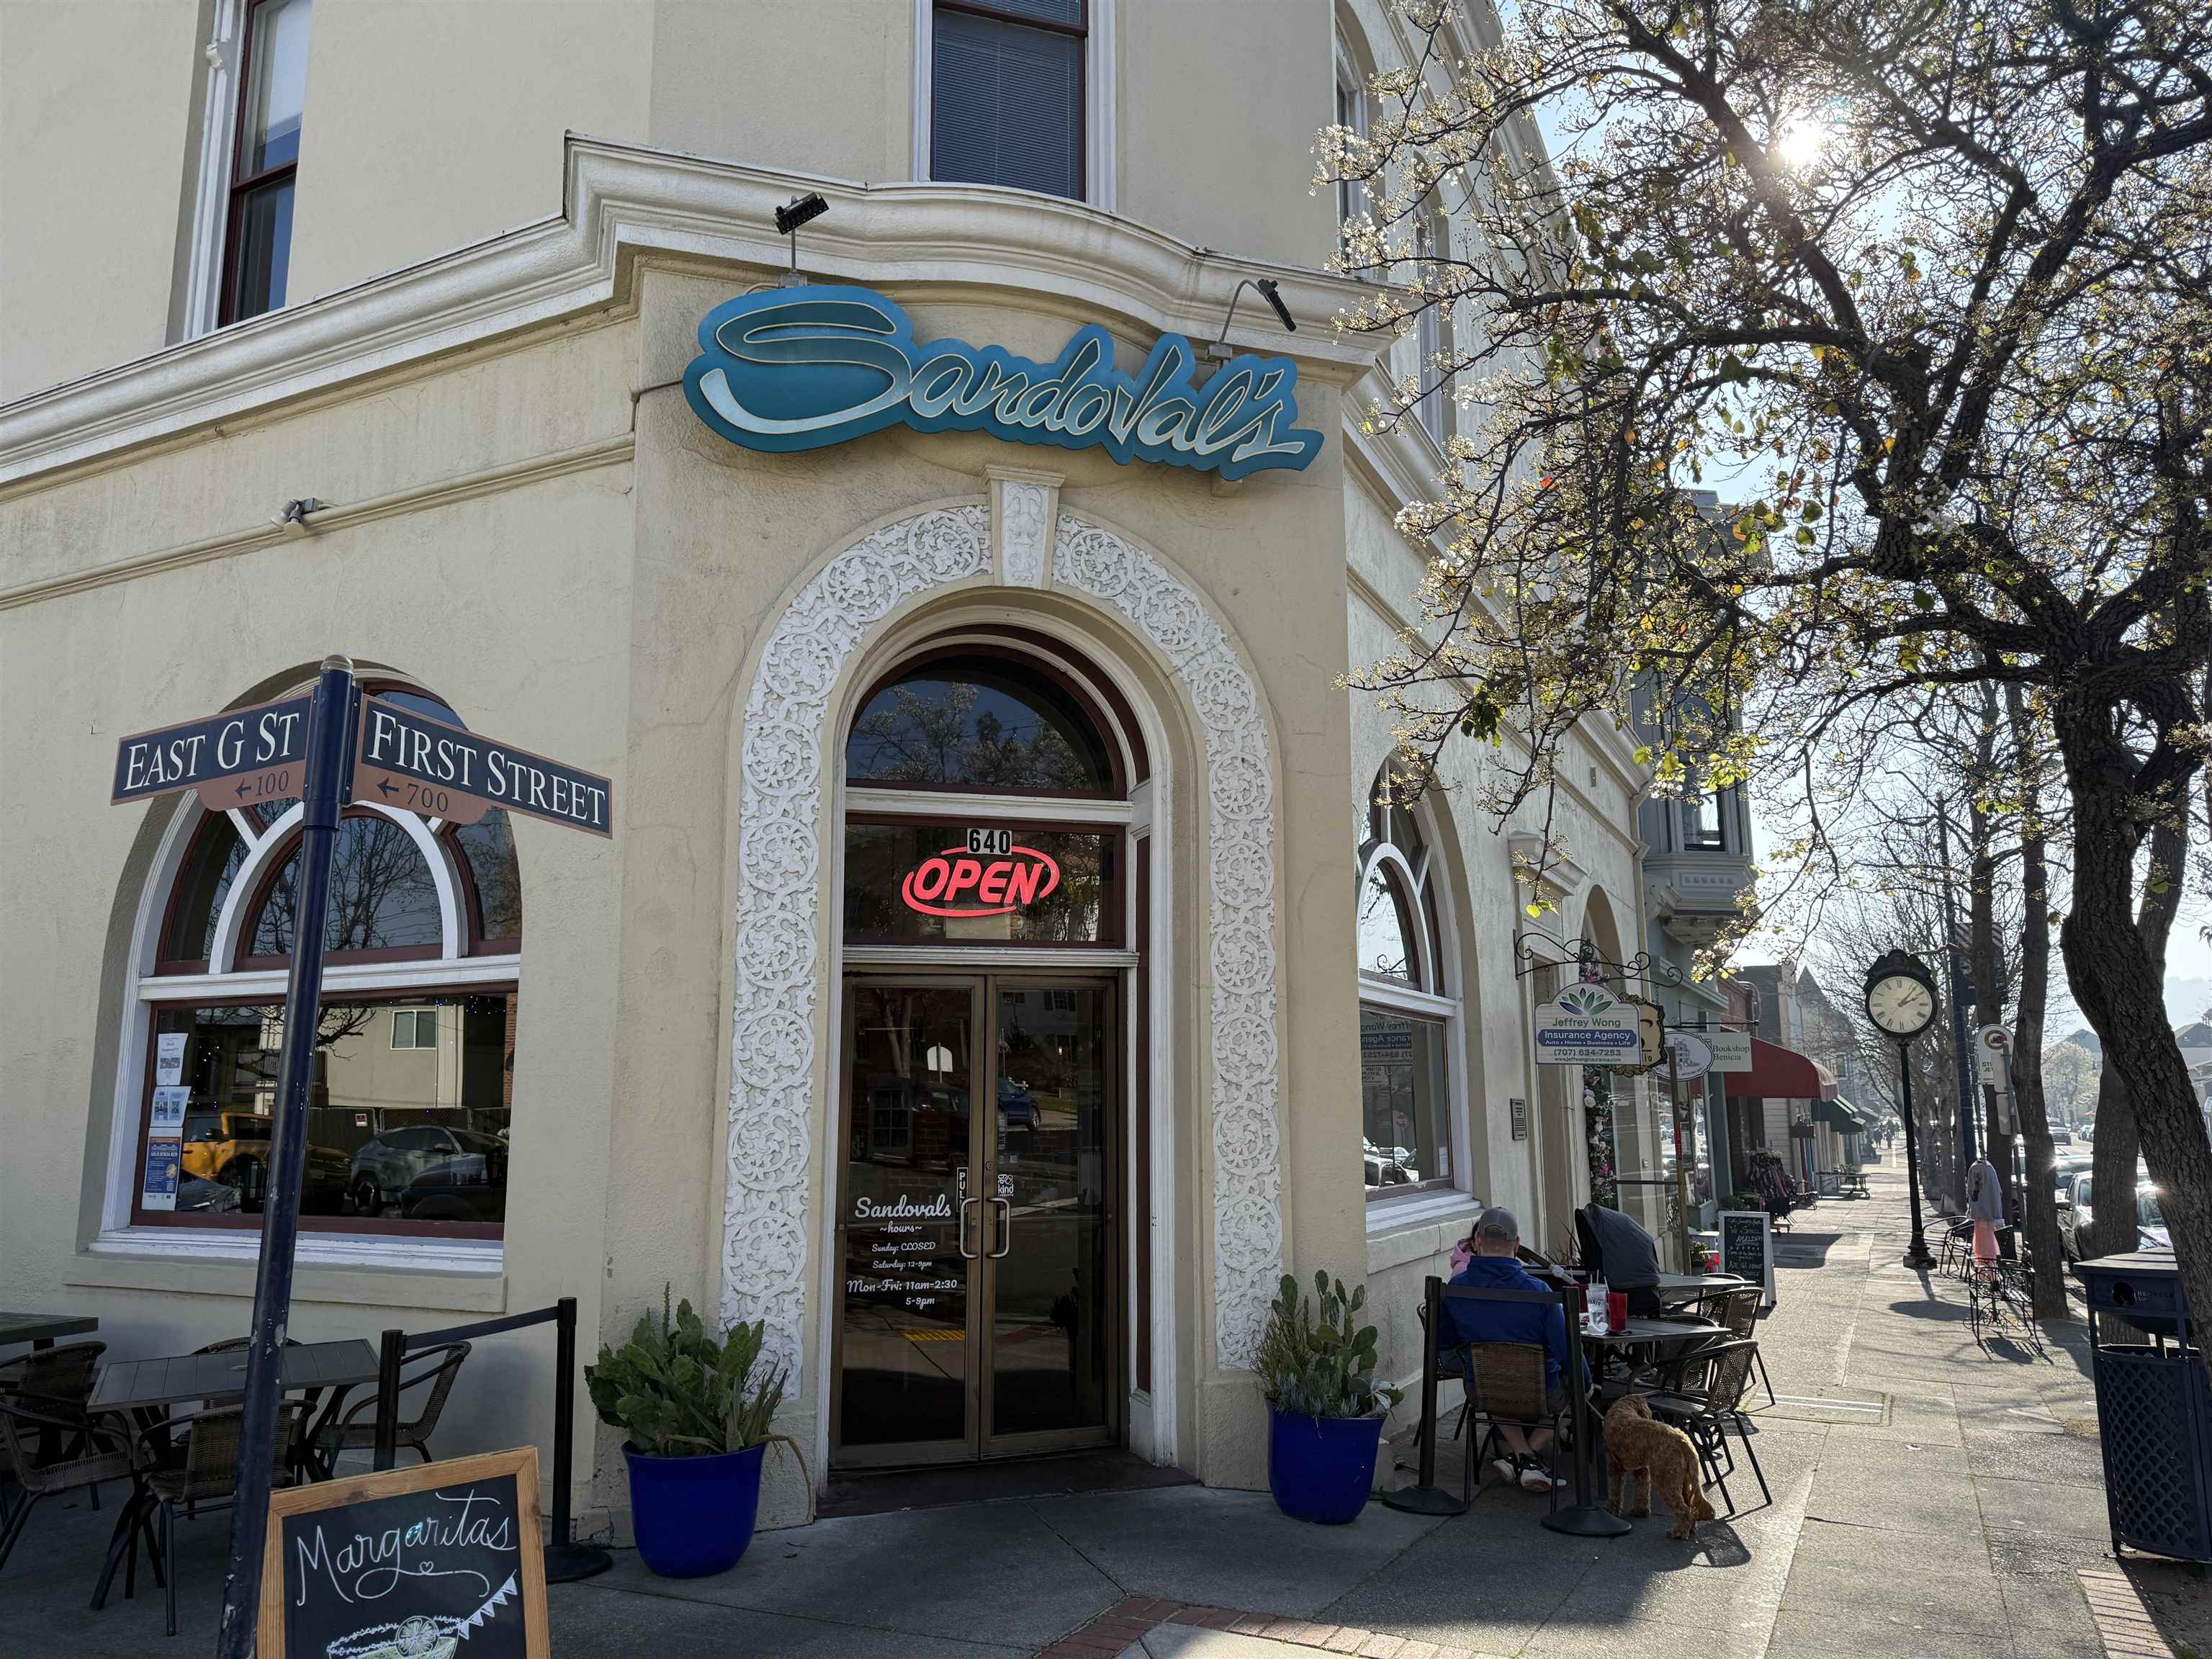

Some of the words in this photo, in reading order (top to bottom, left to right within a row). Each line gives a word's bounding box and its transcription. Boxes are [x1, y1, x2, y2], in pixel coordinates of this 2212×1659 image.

[700, 300, 1305, 462] Sandoval's
[123, 734, 207, 791] EAST
[217, 720, 245, 770] G
[256, 711, 300, 764] ST
[368, 709, 477, 787] FIRST
[487, 751, 606, 826] STREET
[256, 770, 289, 798] 100
[407, 782, 449, 813] 700
[969, 829, 1011, 853] 640
[913, 858, 1044, 904] OPEN
[1552, 1017, 1589, 1028] Jeffrey
[1591, 1018, 1621, 1028] Wong
[1545, 1030, 1591, 1039] Insurance
[1594, 1031, 1630, 1040] Agency
[1554, 1048, 1576, 1057] (707)
[1713, 1044, 1750, 1053] Bookshop
[997, 1183, 1014, 1194] kind
[855, 1193, 952, 1218] Sandovals
[871, 1244, 899, 1255] Sunday:
[901, 1241, 936, 1251] CLOSED
[872, 1261, 906, 1271] Saturday:
[907, 1261, 932, 1271] 12-9pm
[847, 1279, 902, 1293] Mon-Fri:
[905, 1279, 958, 1290] 11am-2:30
[905, 1297, 935, 1310] 5-9pm
[296, 1488, 518, 1607] Margaritas
